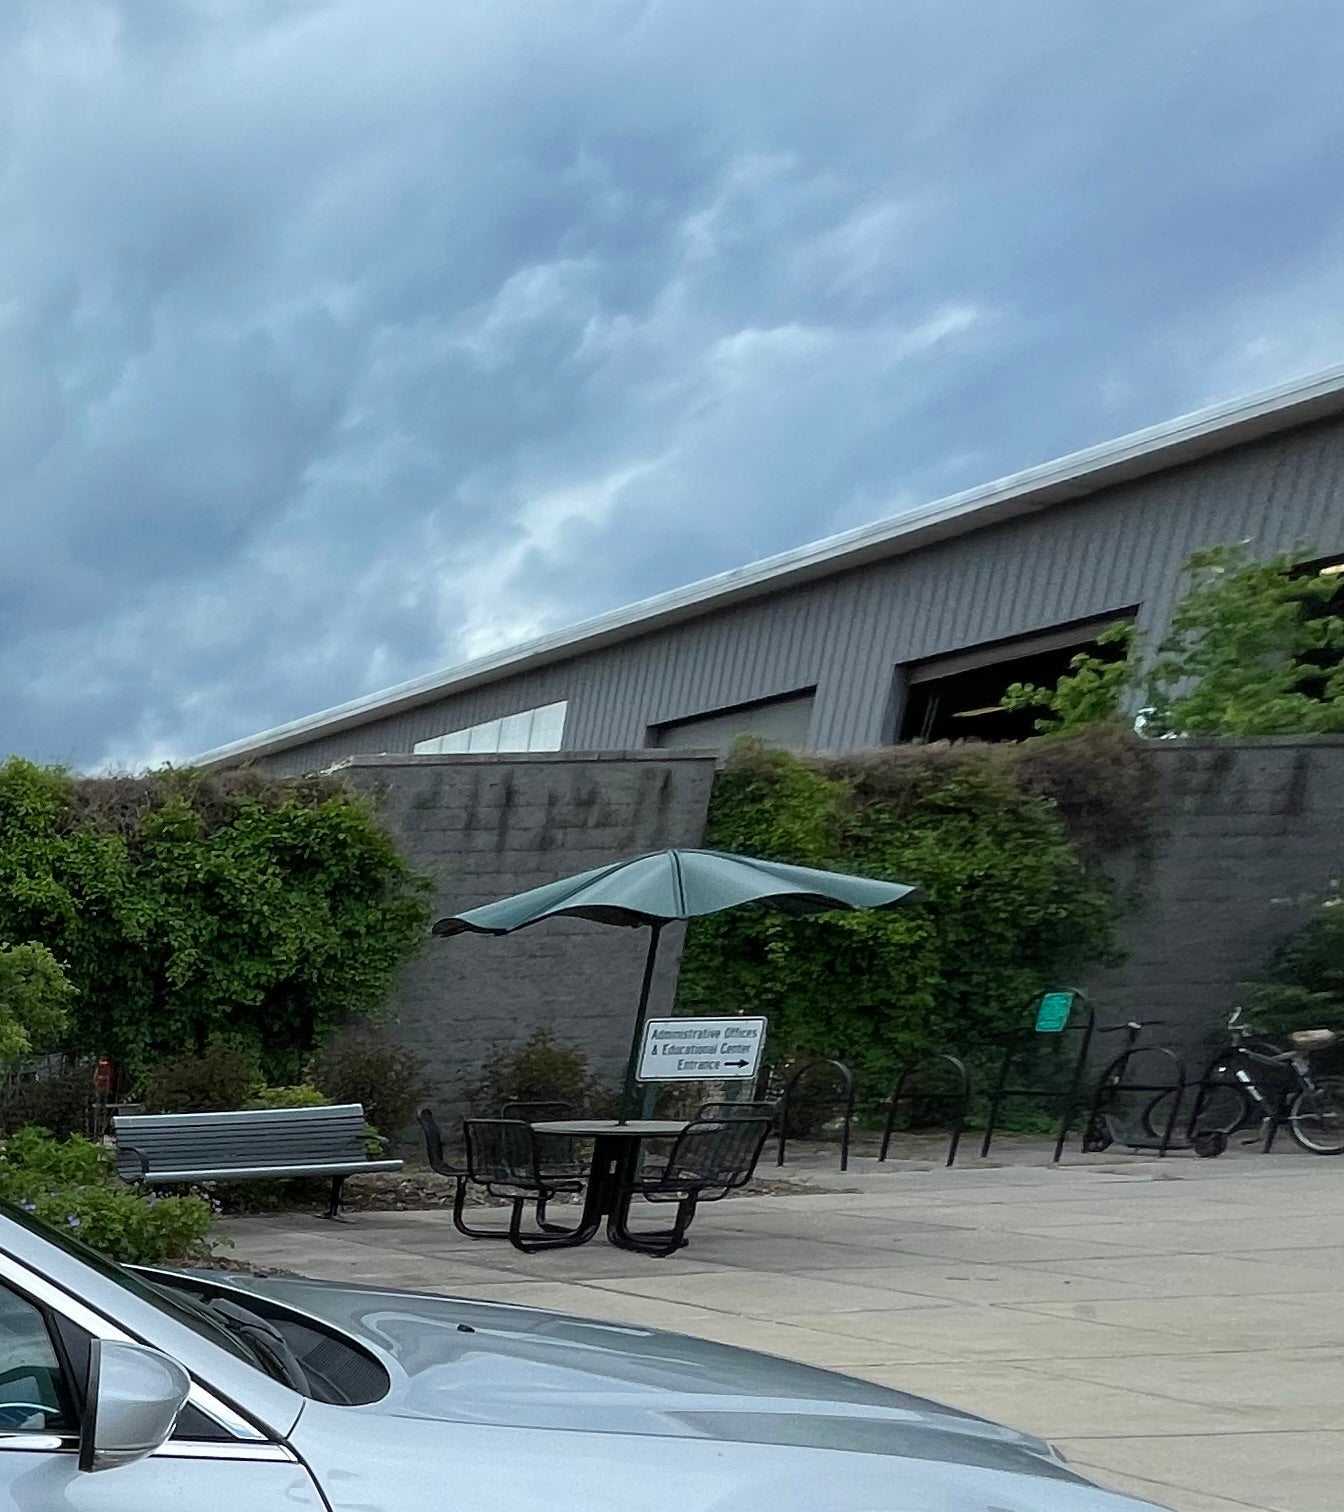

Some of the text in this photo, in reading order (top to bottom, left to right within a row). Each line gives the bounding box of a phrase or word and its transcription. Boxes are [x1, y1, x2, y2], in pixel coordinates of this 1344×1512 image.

[652, 1027, 758, 1039] Administrative Offices
[651, 1043, 752, 1055] & Educational Center
[678, 1059, 721, 1070] Entrance
